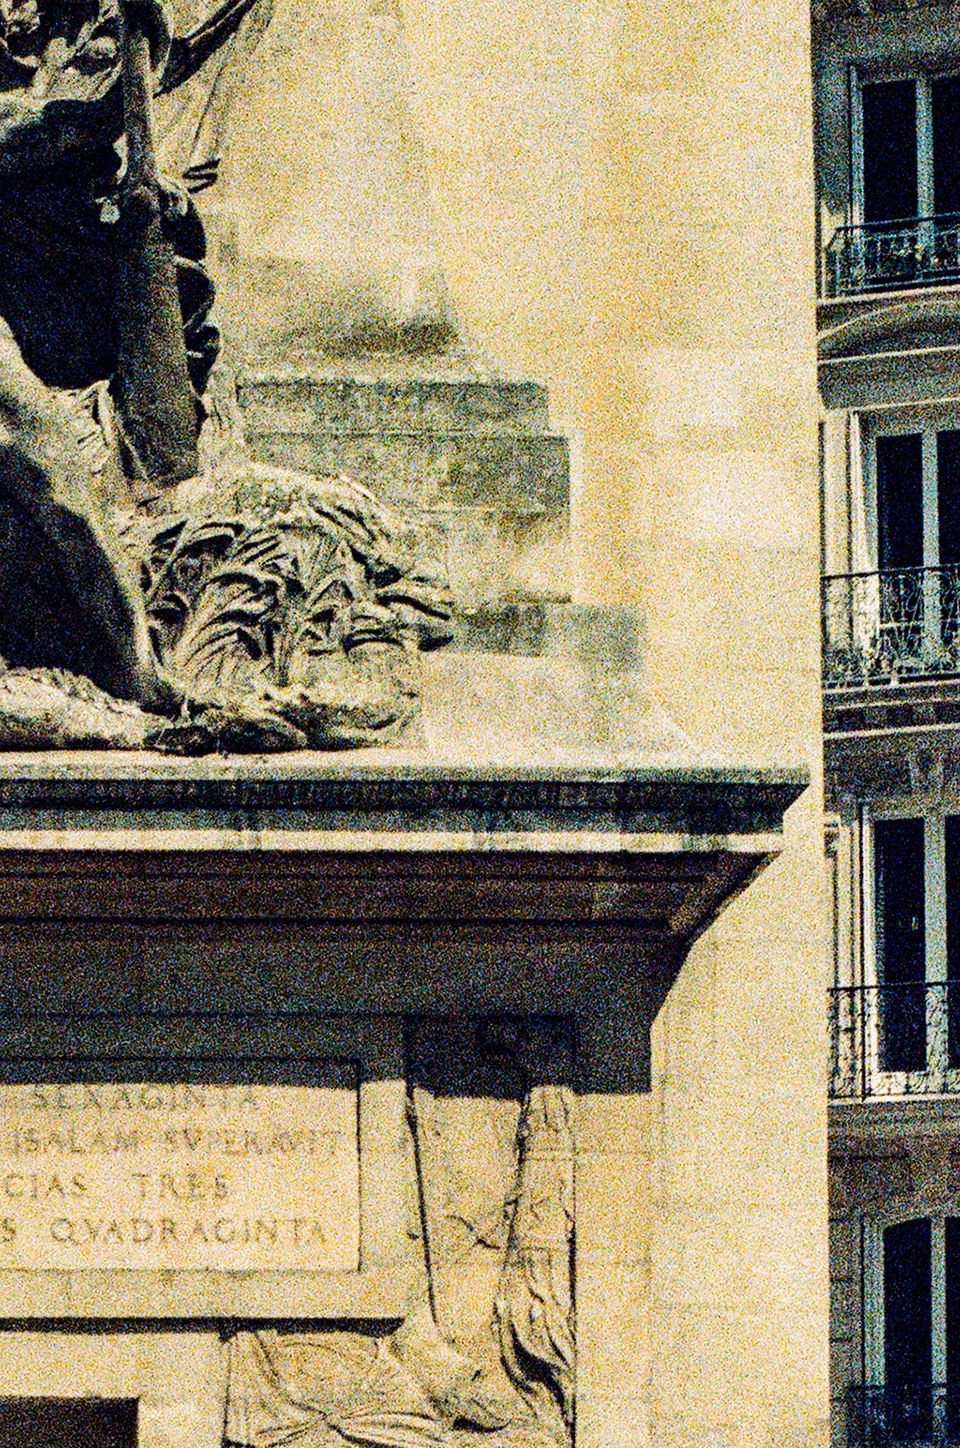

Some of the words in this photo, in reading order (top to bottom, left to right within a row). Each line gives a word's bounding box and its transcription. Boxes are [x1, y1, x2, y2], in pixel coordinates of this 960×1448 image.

[11, 1126, 140, 1157] ISALAM
[131, 1172, 231, 1201] TRES
[49, 1215, 328, 1246] QVADRAGINTA
